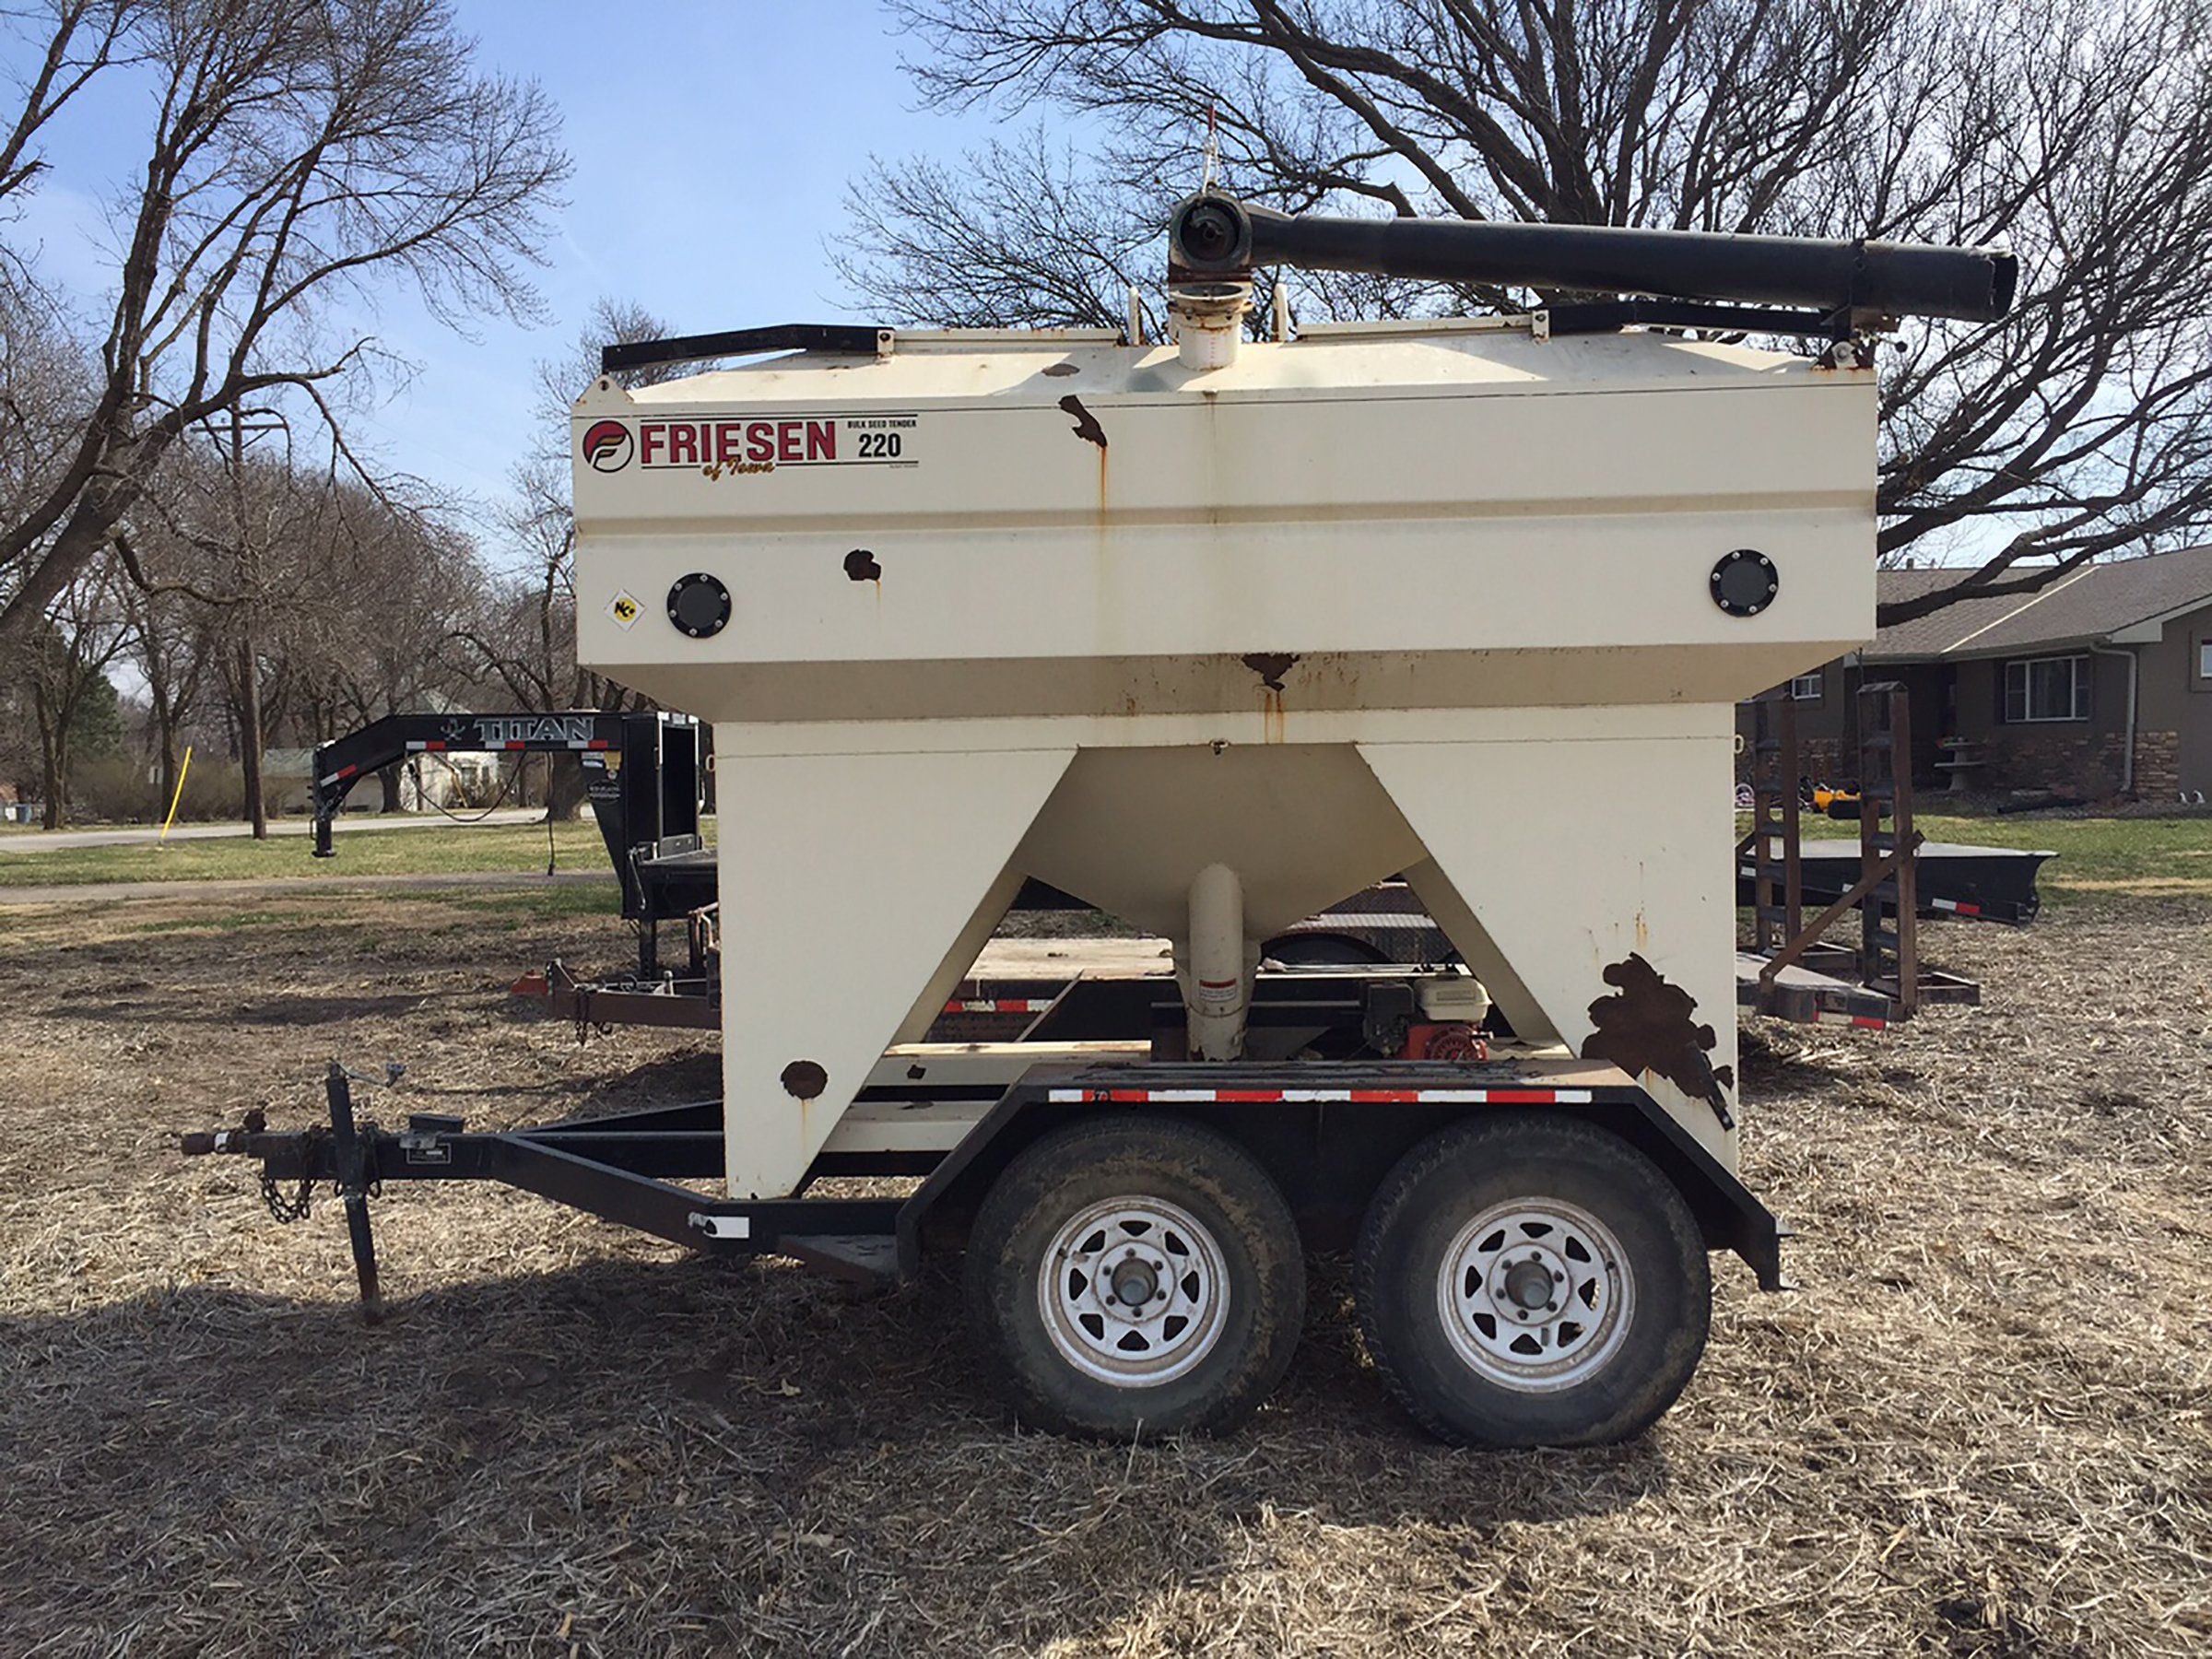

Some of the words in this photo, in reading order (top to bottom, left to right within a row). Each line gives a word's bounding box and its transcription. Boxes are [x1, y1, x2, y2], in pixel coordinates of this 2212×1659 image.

[640, 420, 838, 464] FRIESEN
[858, 432, 901, 457] 220
[473, 716, 595, 741] TITAN
